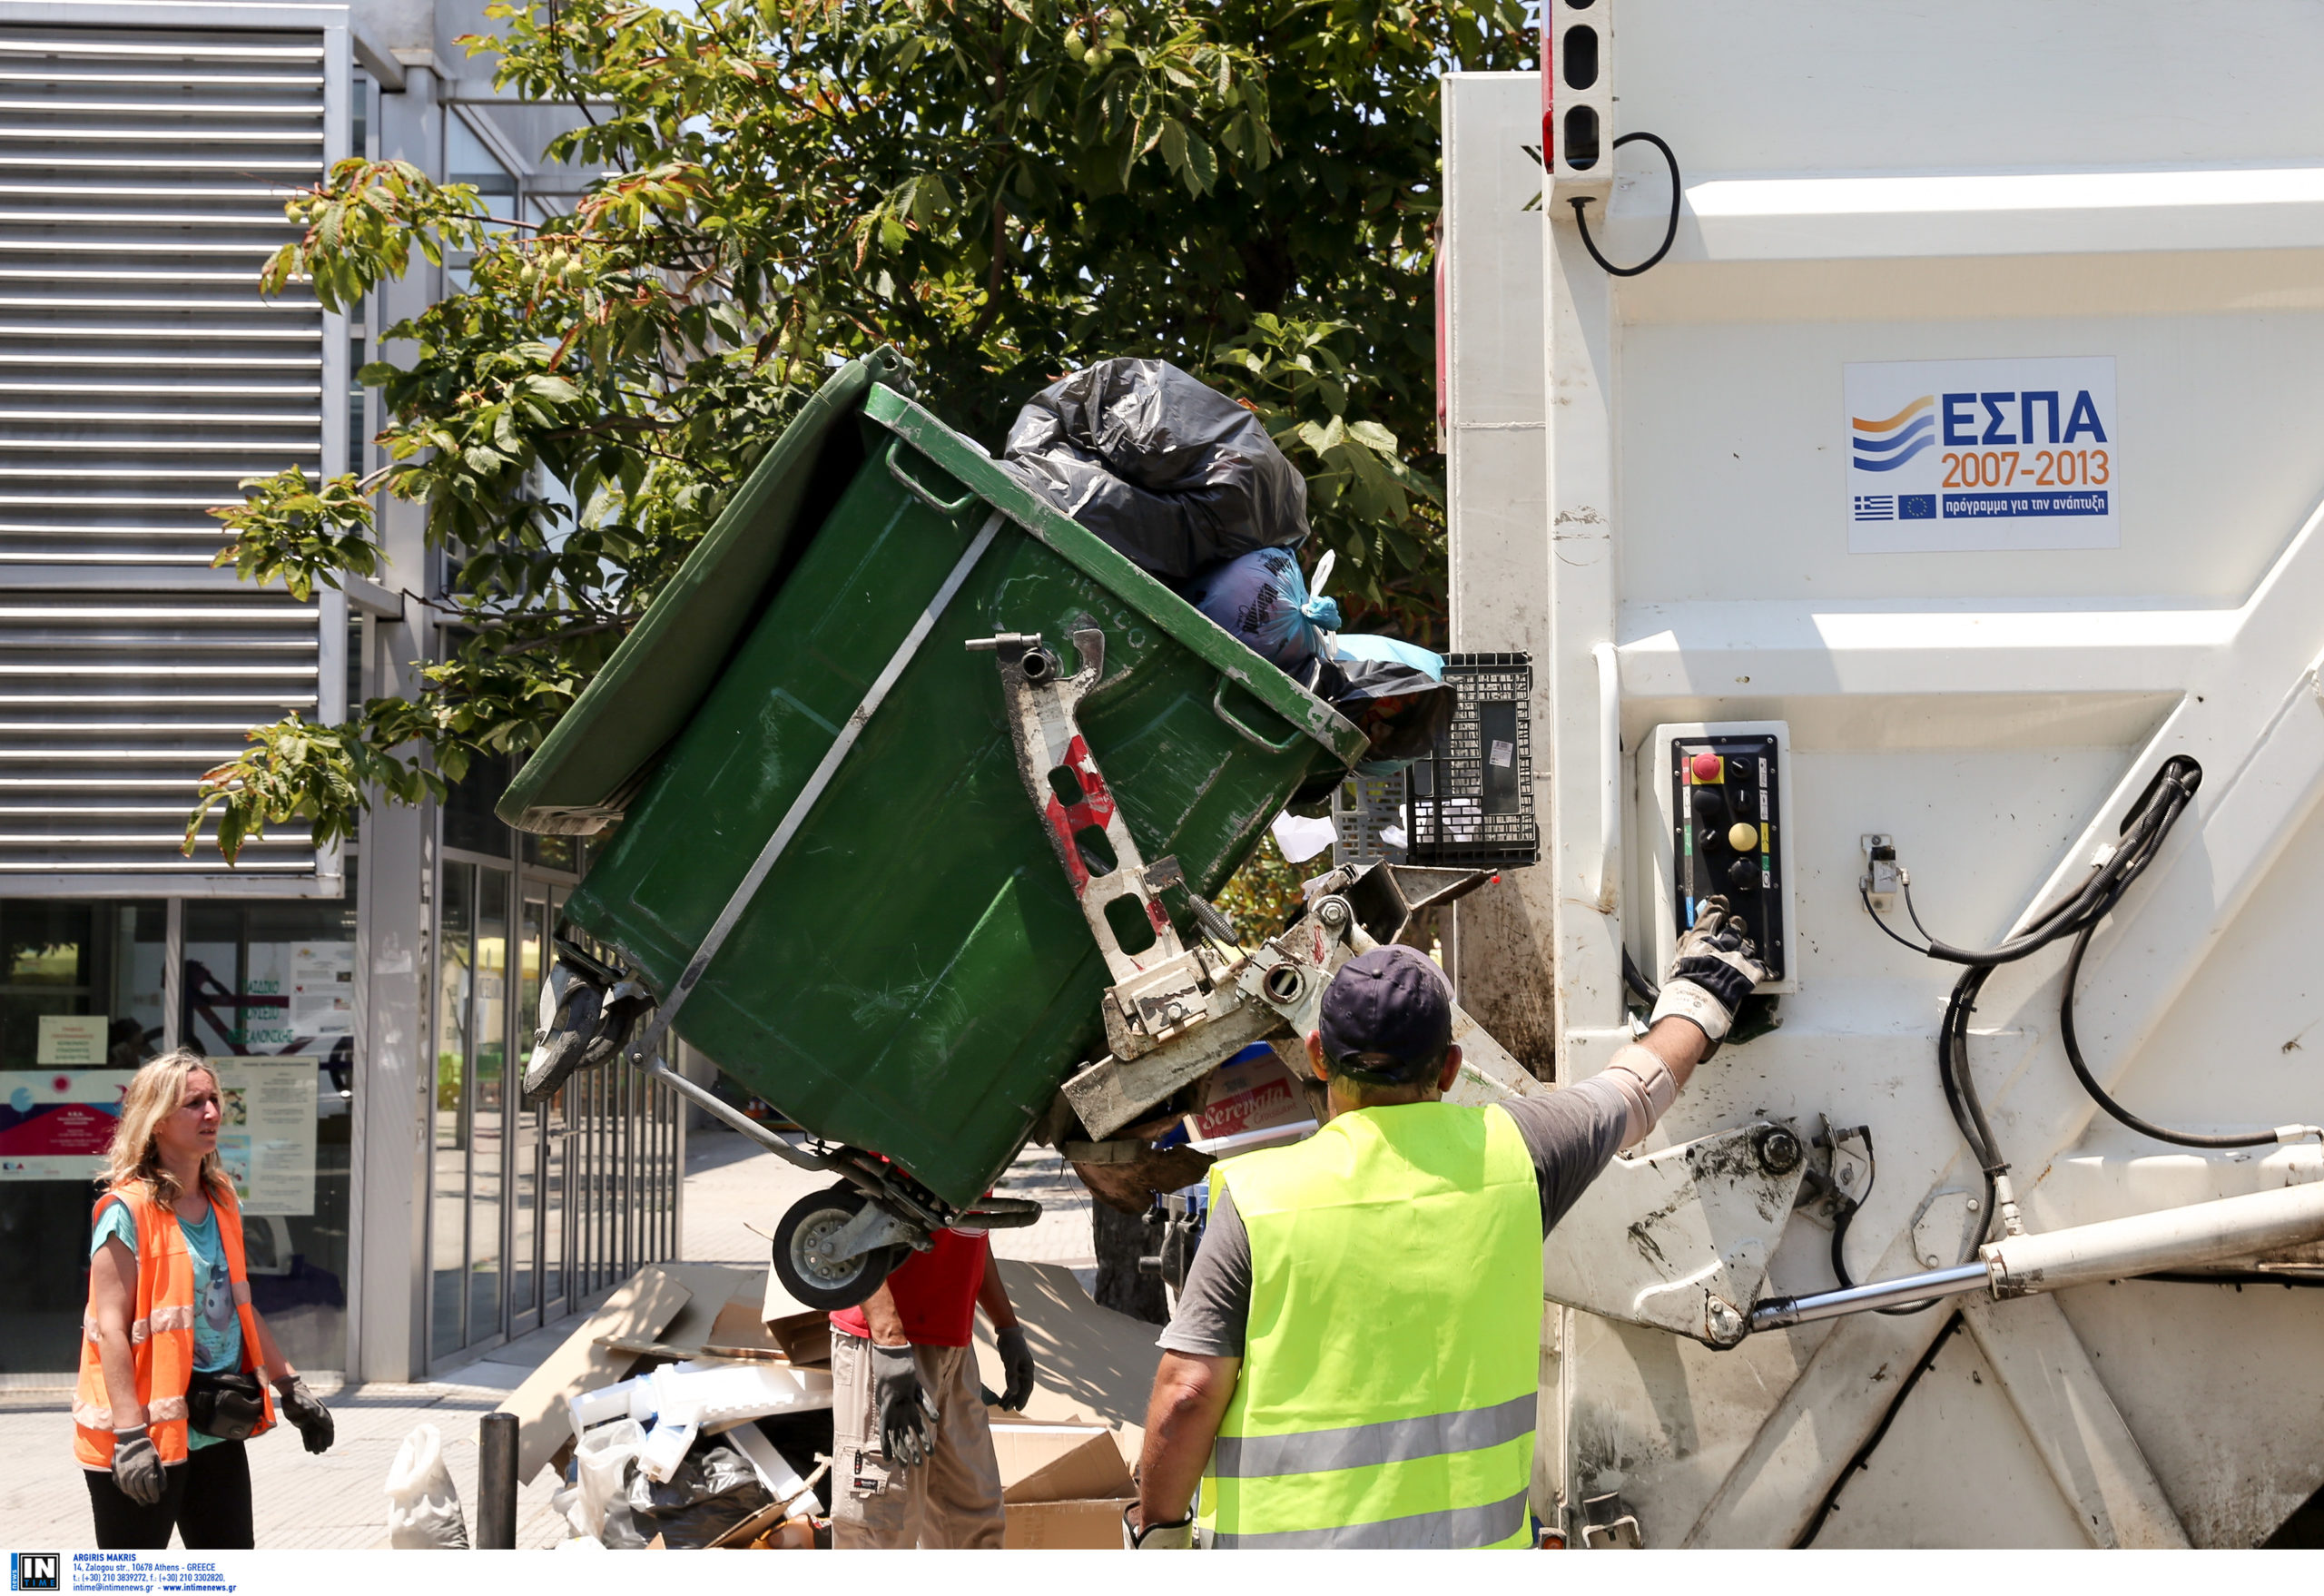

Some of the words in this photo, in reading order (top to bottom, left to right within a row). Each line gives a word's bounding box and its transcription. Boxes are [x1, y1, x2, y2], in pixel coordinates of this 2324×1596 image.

[1943, 390, 2108, 446] ΕΣΠΑ
[1941, 449, 2110, 488] 2007-2013
[1945, 497, 2008, 516] πρόγραμμα
[2010, 499, 2029, 515] για
[2032, 498, 2050, 510] την
[2053, 494, 2105, 513] ανάπτυξη
[1203, 1087, 1285, 1130] Serenata
